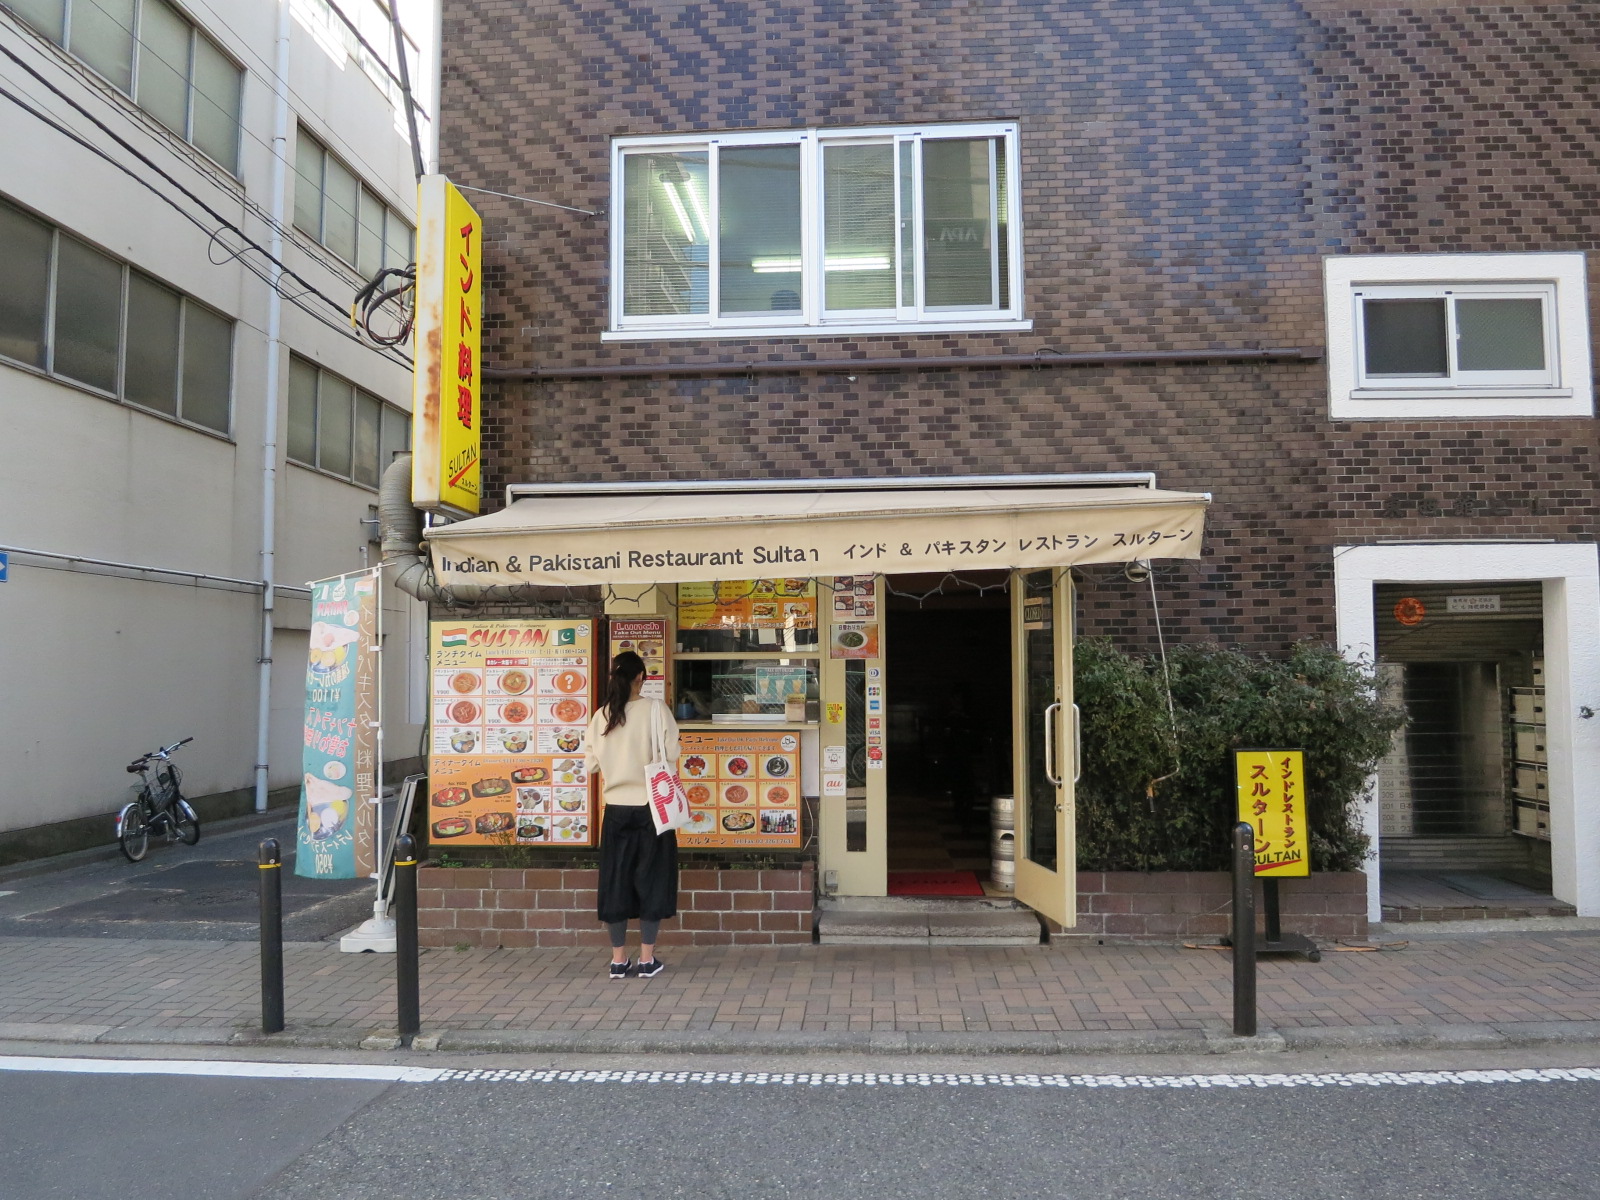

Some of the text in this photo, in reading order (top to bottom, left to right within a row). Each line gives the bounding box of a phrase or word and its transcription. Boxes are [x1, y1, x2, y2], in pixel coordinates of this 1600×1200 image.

[457, 222, 473, 430] インド料理
[449, 442, 477, 478] SULTAN
[843, 528, 1194, 559] インド & パキスタン レストラン スルターン
[506, 555, 522, 572] &
[529, 551, 620, 571] Pakistani
[628, 549, 744, 568] Restaurant
[1024, 606, 1042, 621] CLOSED
[616, 622, 660, 631] Lunch
[469, 628, 549, 648] SULTAN
[436, 650, 482, 658] ランチタイム
[434, 758, 481, 767] ディナータイム
[1250, 764, 1271, 854] スルターン
[1280, 757, 1296, 849] インドレストラン
[687, 837, 727, 845] スルターン
